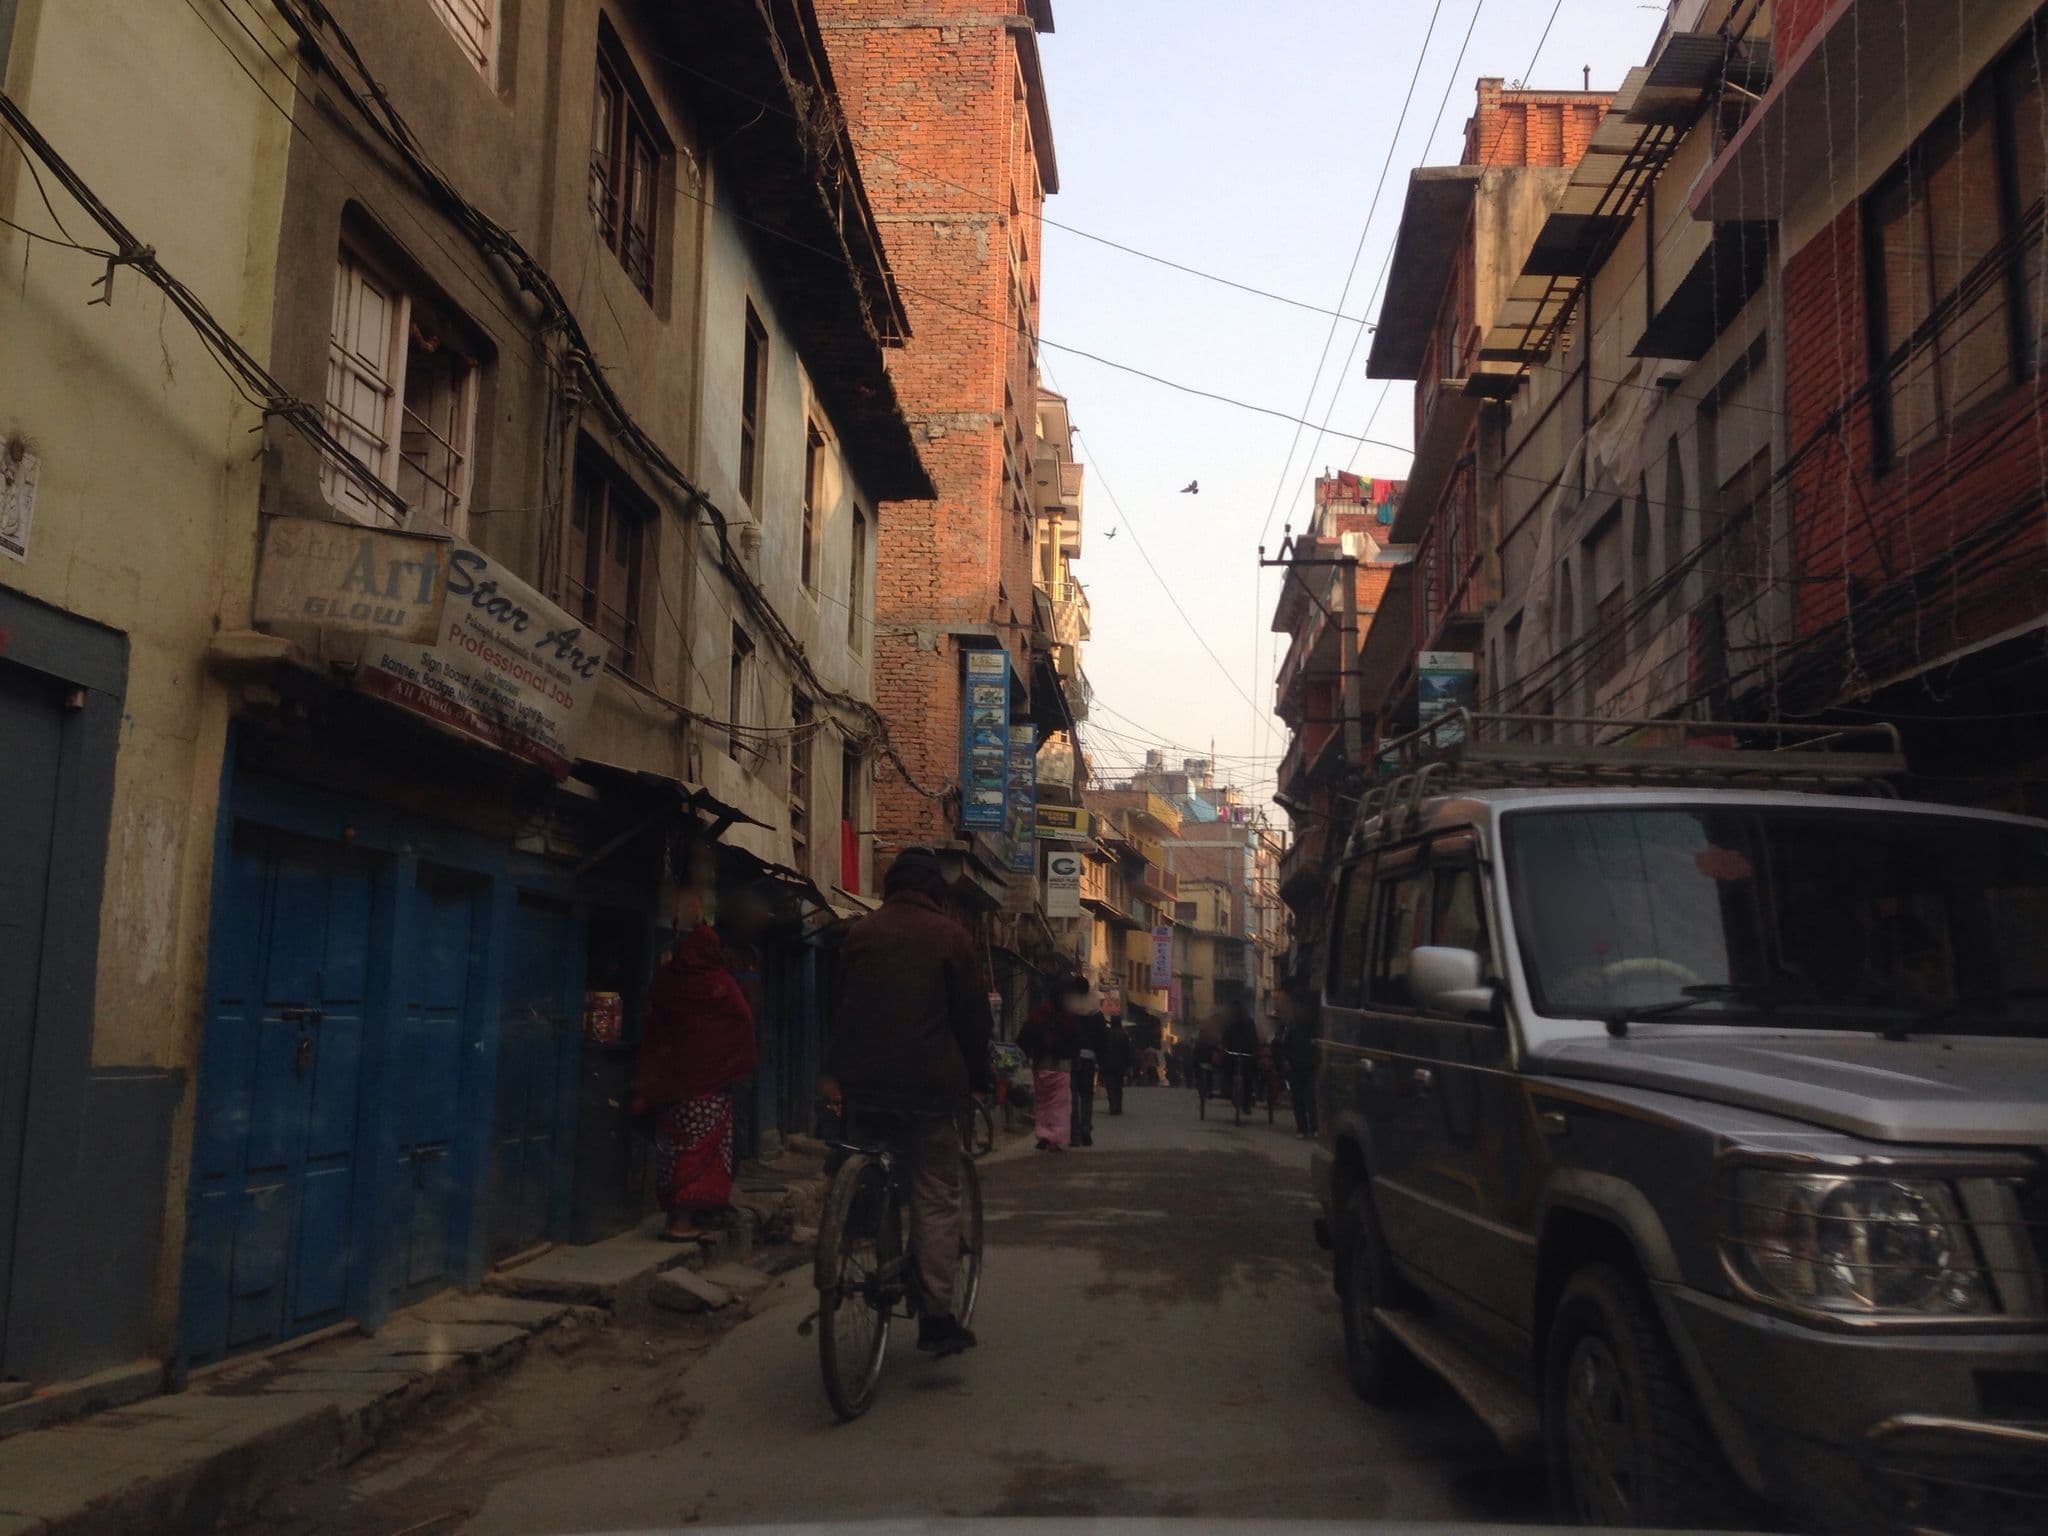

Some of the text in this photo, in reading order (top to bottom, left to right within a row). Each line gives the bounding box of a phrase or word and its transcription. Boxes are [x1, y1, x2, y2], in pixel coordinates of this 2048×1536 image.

[337, 537, 440, 605] Art
[303, 596, 406, 626] GLOW
[446, 549, 529, 632] Star
[535, 628, 600, 678] Art
[420, 651, 442, 673] Sign
[448, 623, 545, 693] Professional
[548, 684, 574, 710] Job
[395, 682, 415, 698] All
[417, 689, 452, 715] Kinds
